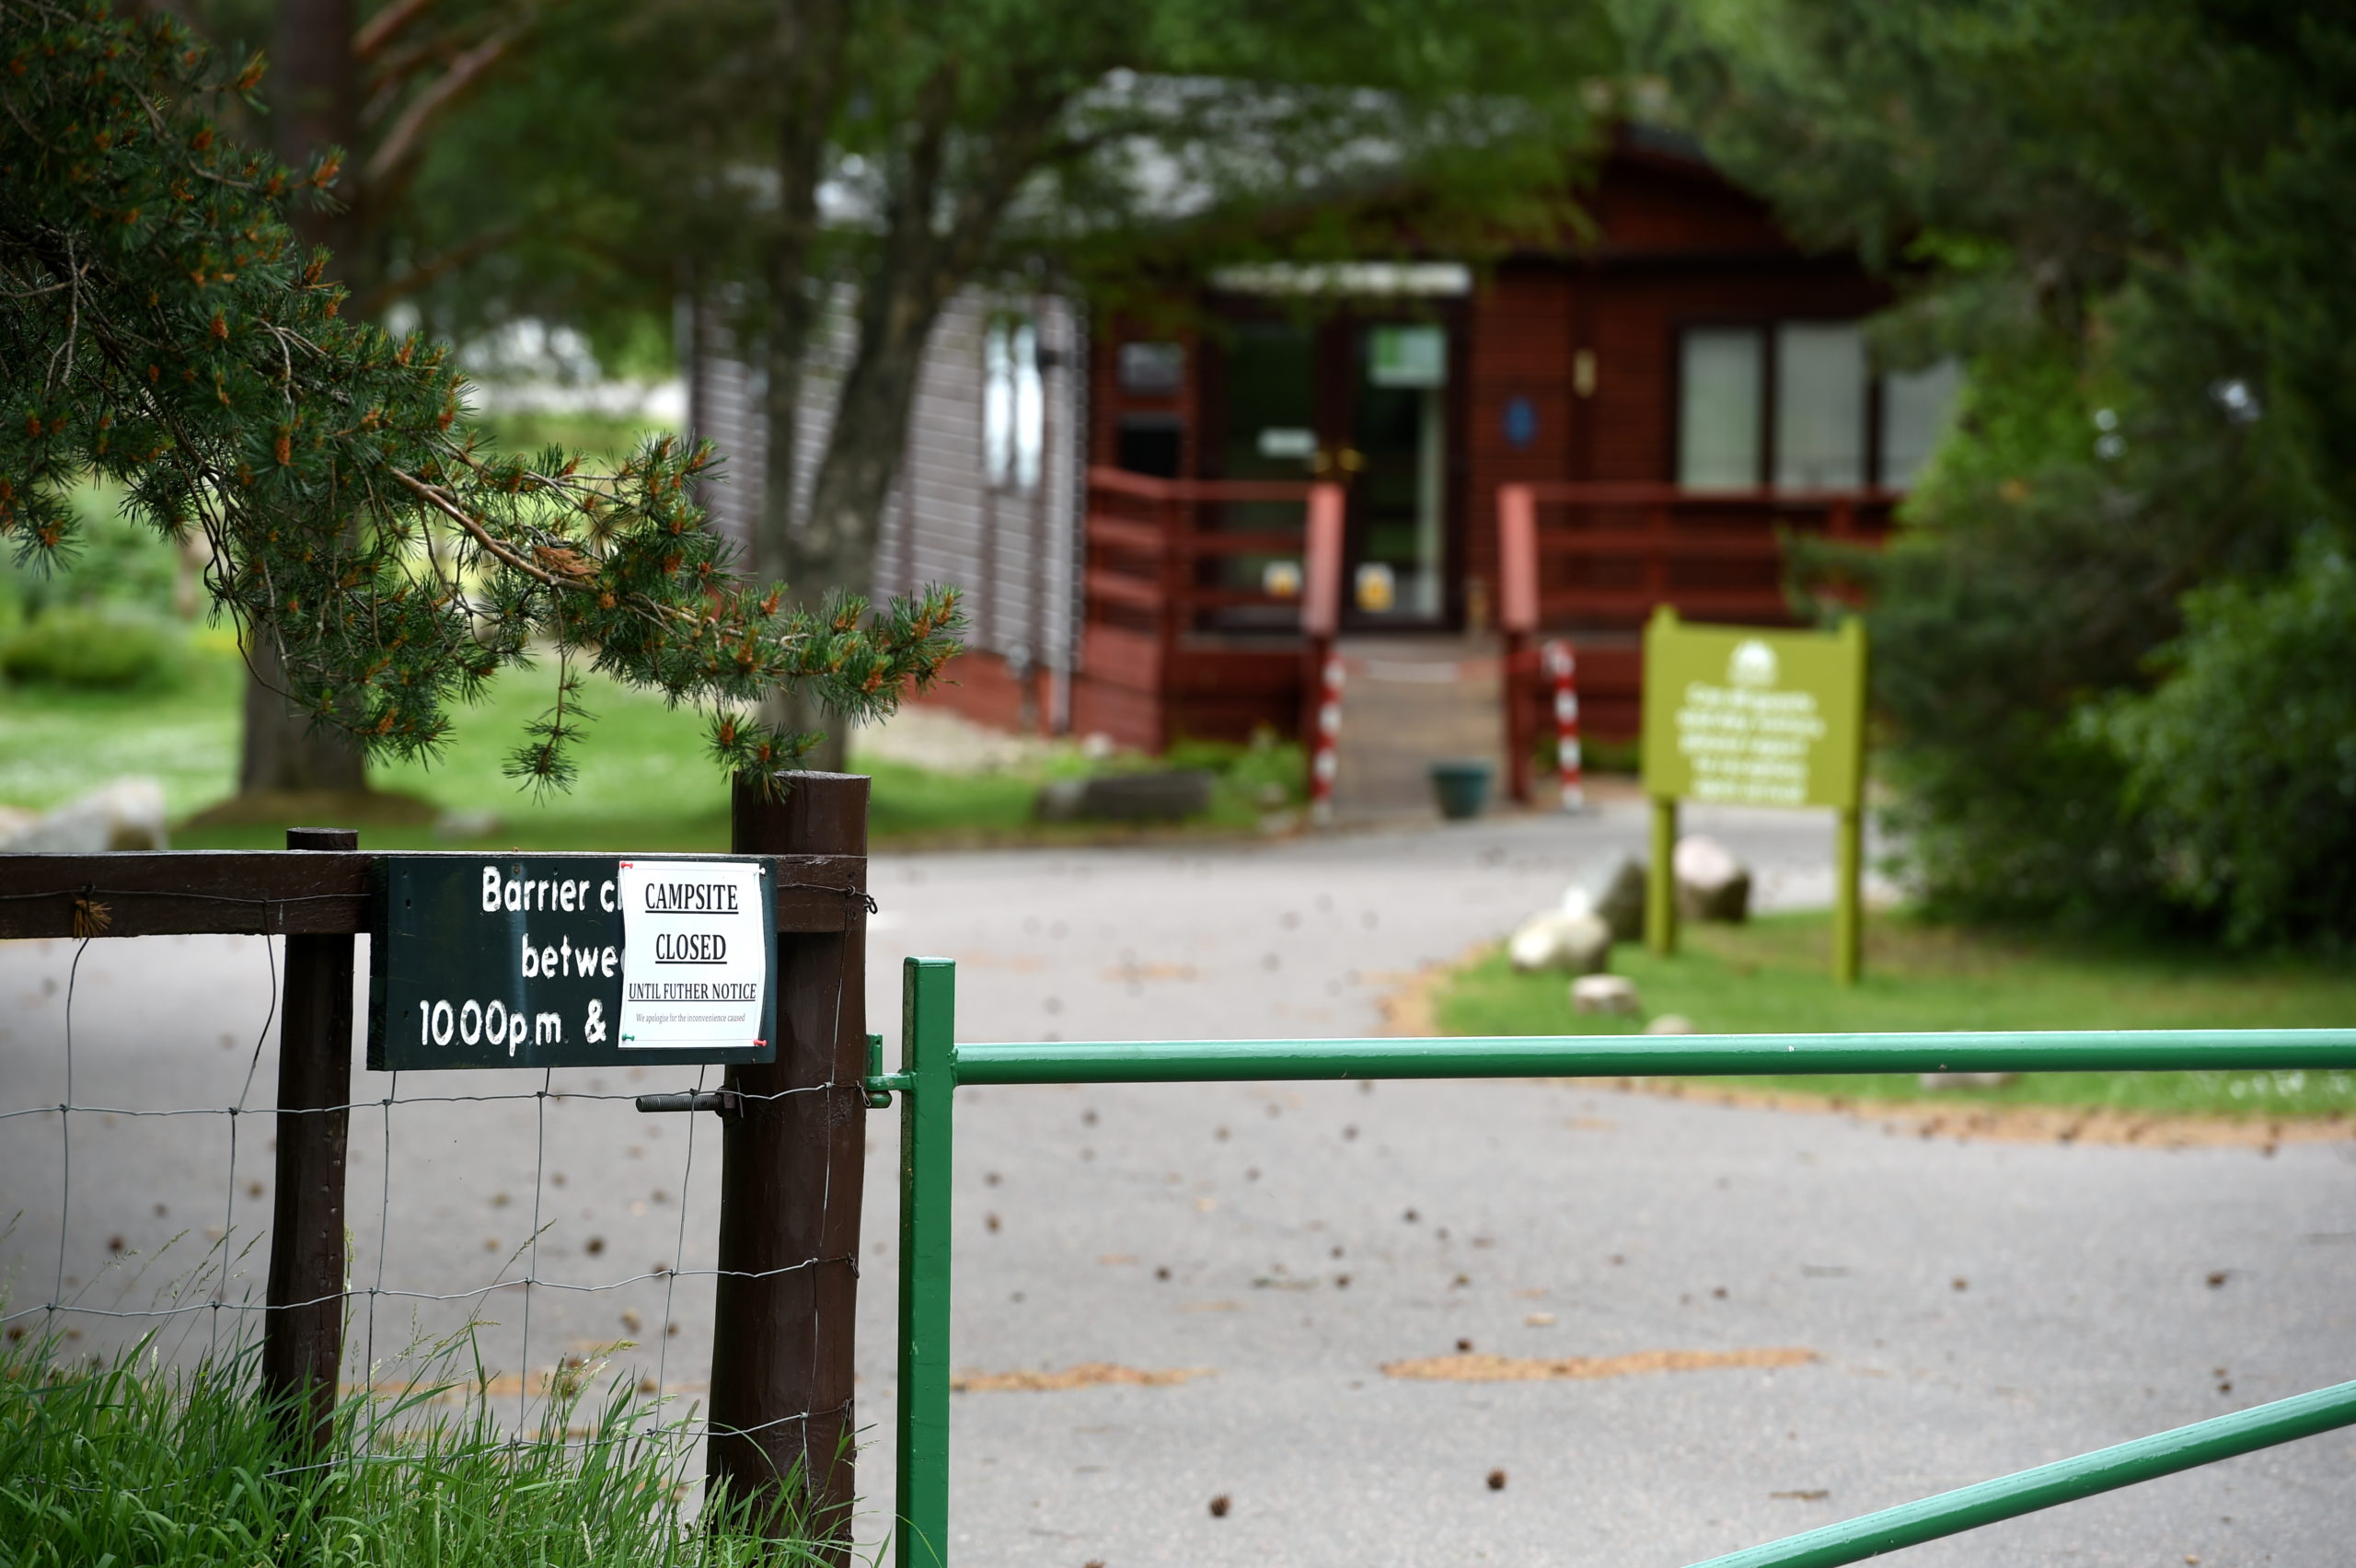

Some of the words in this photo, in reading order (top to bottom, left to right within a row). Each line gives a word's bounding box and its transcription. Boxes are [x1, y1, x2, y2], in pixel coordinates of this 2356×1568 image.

[483, 865, 590, 913] Barrier
[645, 882, 738, 911] CAMPSITE
[655, 932, 727, 960] CLOSED
[629, 983, 661, 999] UNTIL
[664, 983, 709, 999] FUTHER
[712, 983, 757, 999] NOTICE
[584, 998, 606, 1044] &
[636, 1013, 645, 1022] We
[646, 1013, 669, 1024] apologise
[678, 1013, 687, 1022] the
[687, 1013, 726, 1022] inconvenience
[727, 1013, 745, 1022] caused
